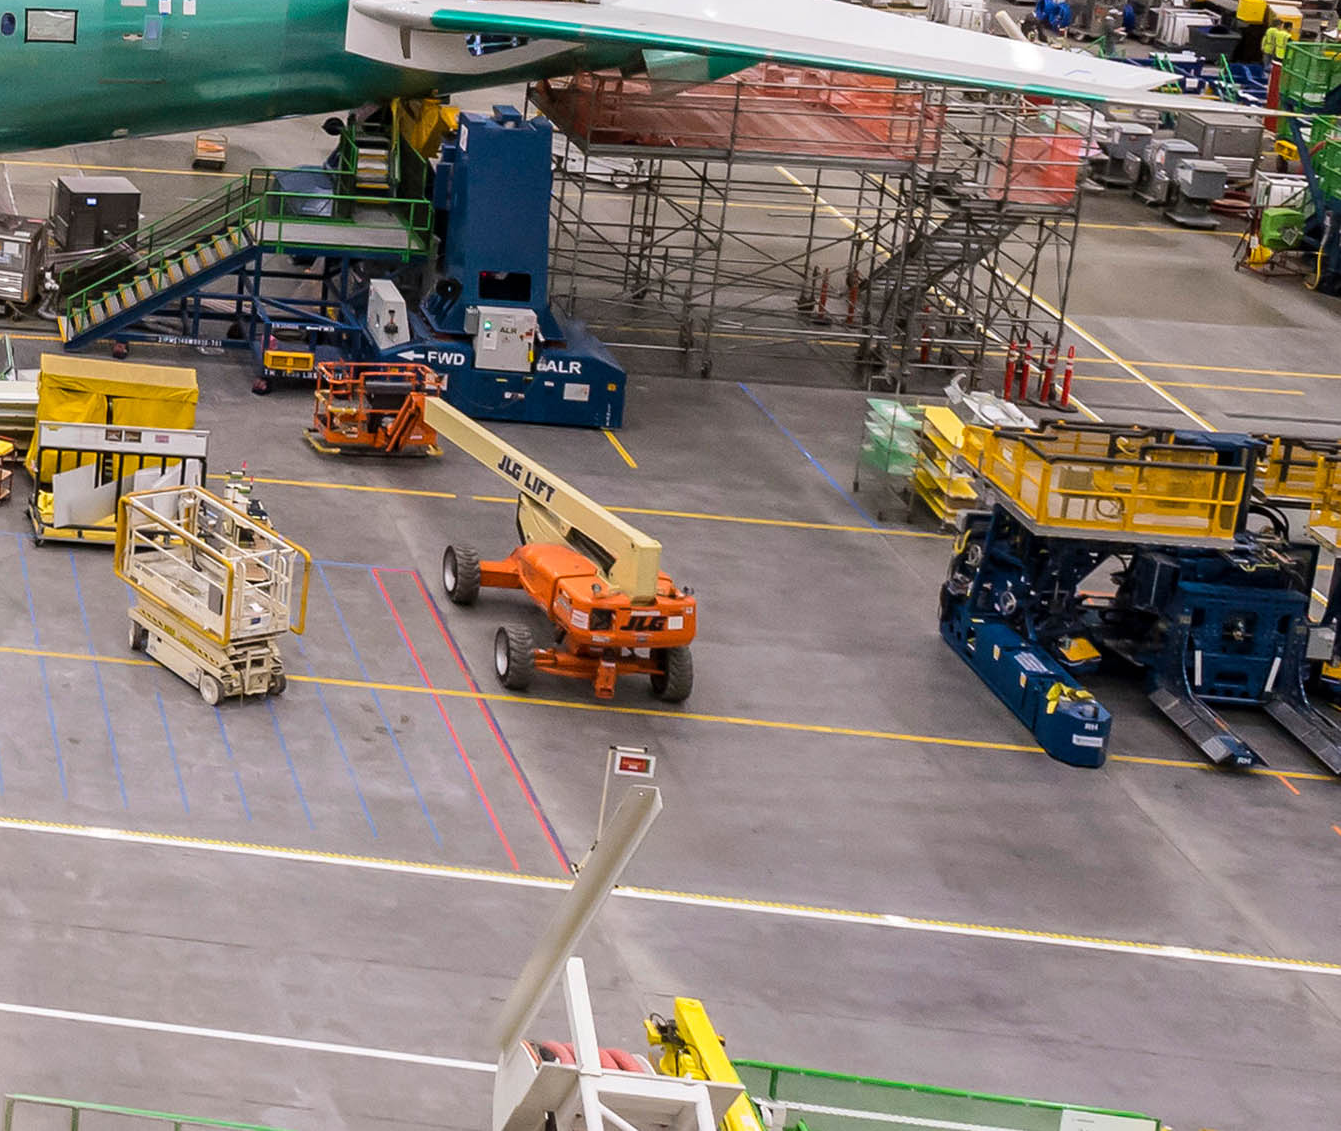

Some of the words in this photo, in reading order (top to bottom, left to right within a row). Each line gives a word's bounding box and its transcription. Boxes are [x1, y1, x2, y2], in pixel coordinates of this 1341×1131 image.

[427, 351, 465, 366] FWD
[547, 360, 582, 375] ALR
[498, 455, 523, 481] JLG
[524, 471, 556, 503] LIFT
[620, 616, 668, 631] JLG
